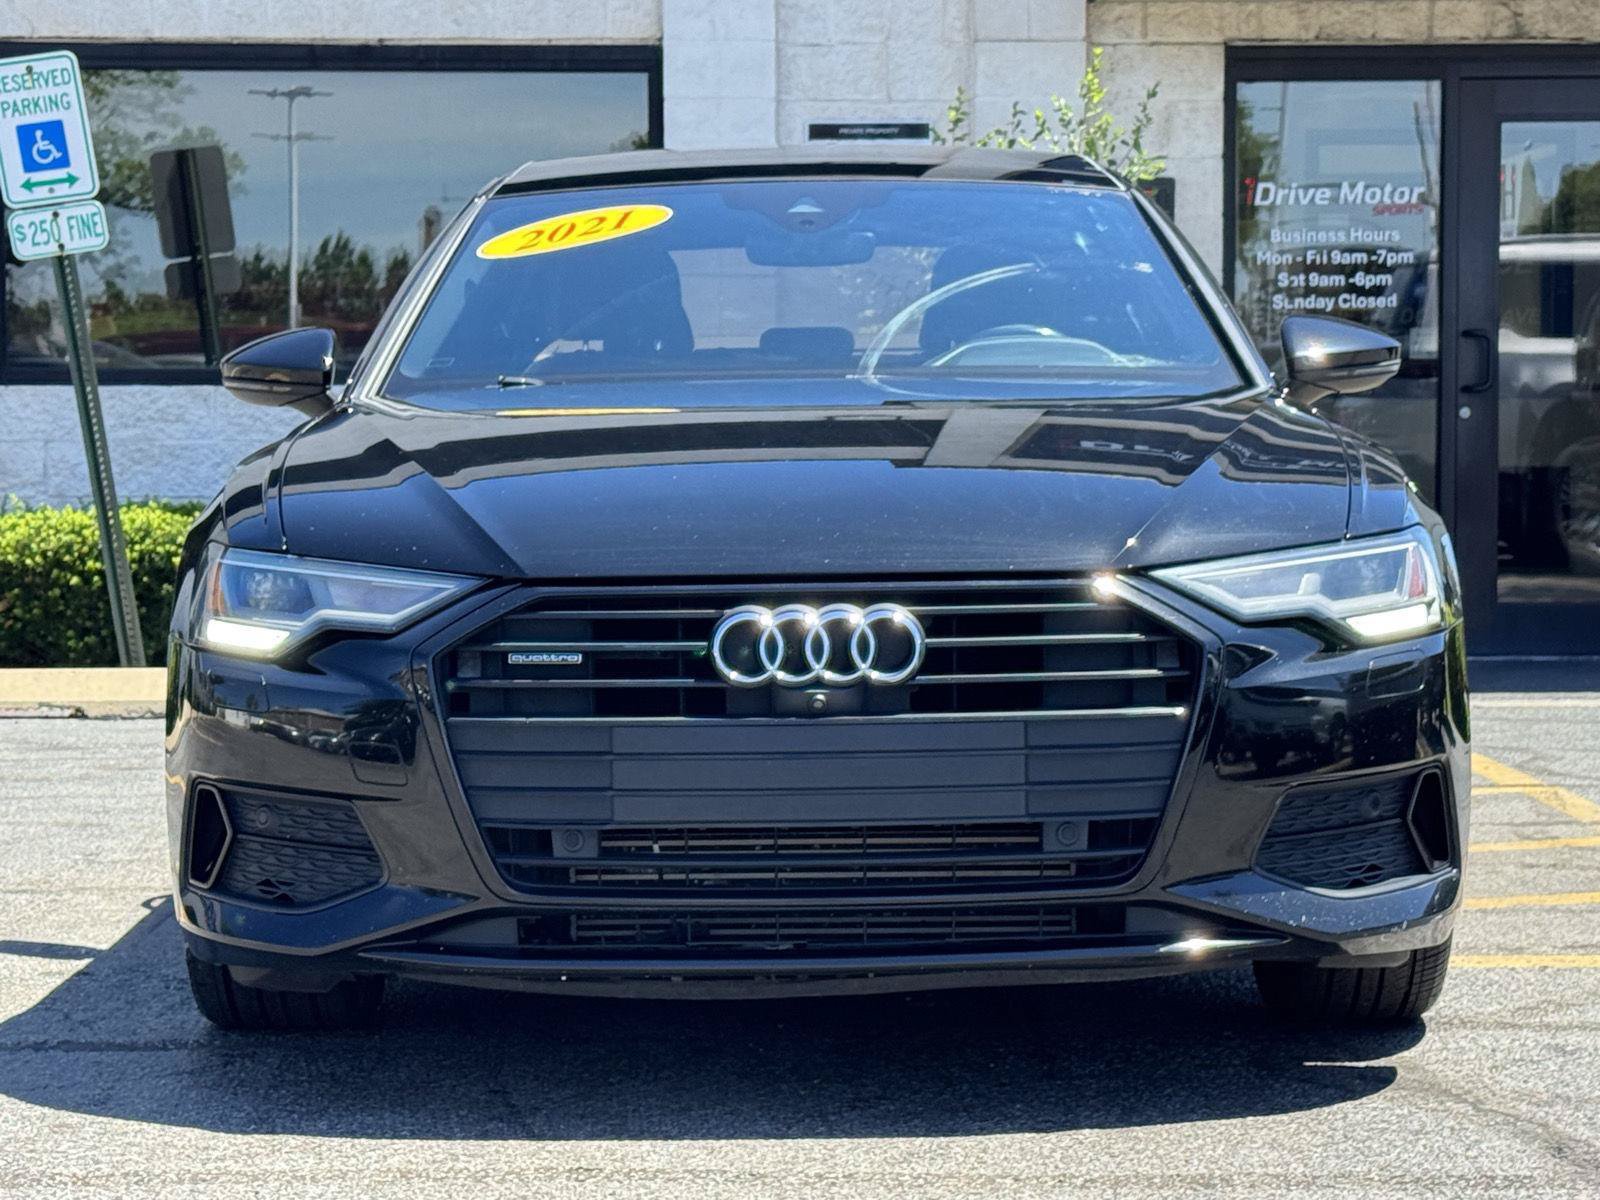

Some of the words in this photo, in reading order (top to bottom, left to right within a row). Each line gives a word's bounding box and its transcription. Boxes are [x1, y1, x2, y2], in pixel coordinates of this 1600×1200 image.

[0, 68, 71, 93] ESERVED
[1, 92, 71, 118] PARKING
[1339, 181, 1426, 205] Motor
[14, 217, 61, 247] $250
[67, 212, 104, 242] FINE
[515, 210, 634, 251] 2021
[1270, 228, 1346, 243] Business
[1350, 228, 1400, 243] Hours
[1256, 251, 1293, 265] Mon
[1331, 250, 1367, 265] 9am
[1308, 272, 1345, 287] 9am
[1338, 293, 1397, 308] Closed
[511, 654, 578, 663] quattro
